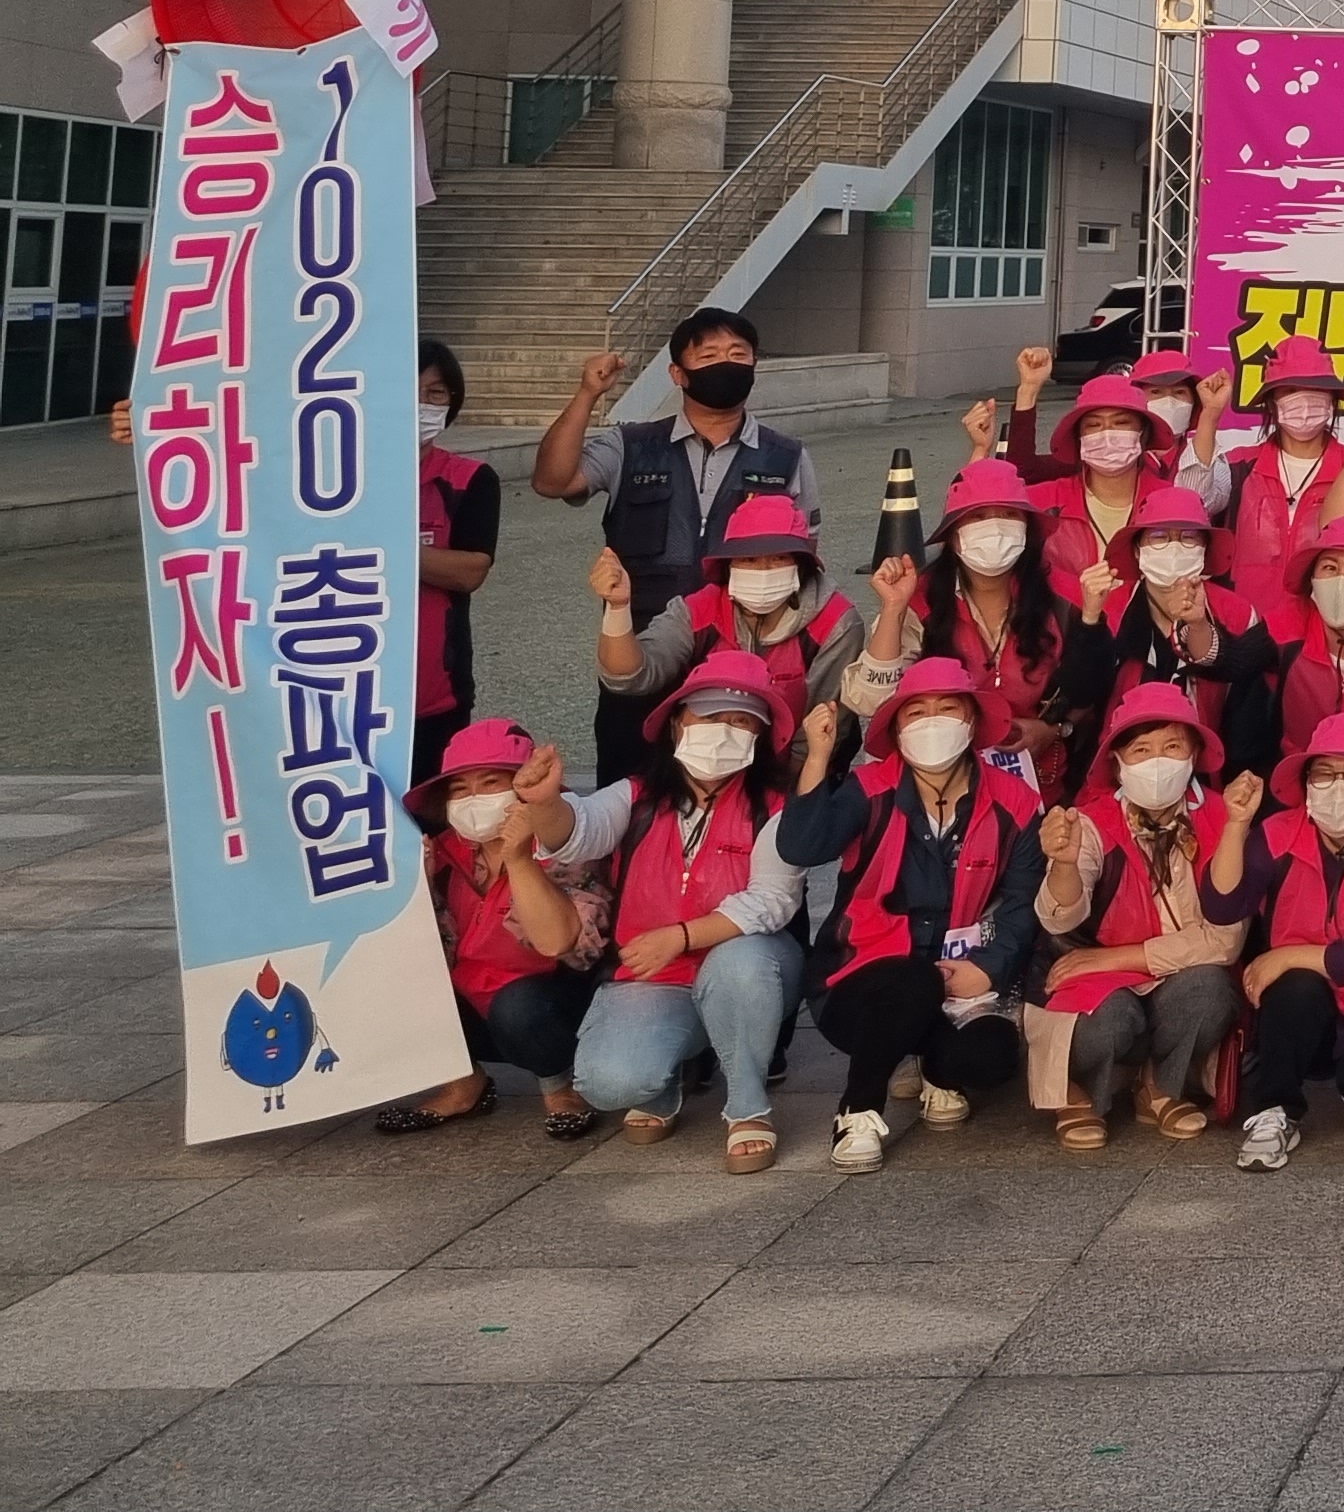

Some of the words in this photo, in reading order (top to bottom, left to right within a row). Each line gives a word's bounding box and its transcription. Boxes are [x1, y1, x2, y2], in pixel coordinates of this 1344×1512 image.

[147, 75, 280, 859] 승리하자!
[298, 60, 359, 512] 1020
[273, 547, 389, 897] 총파업
